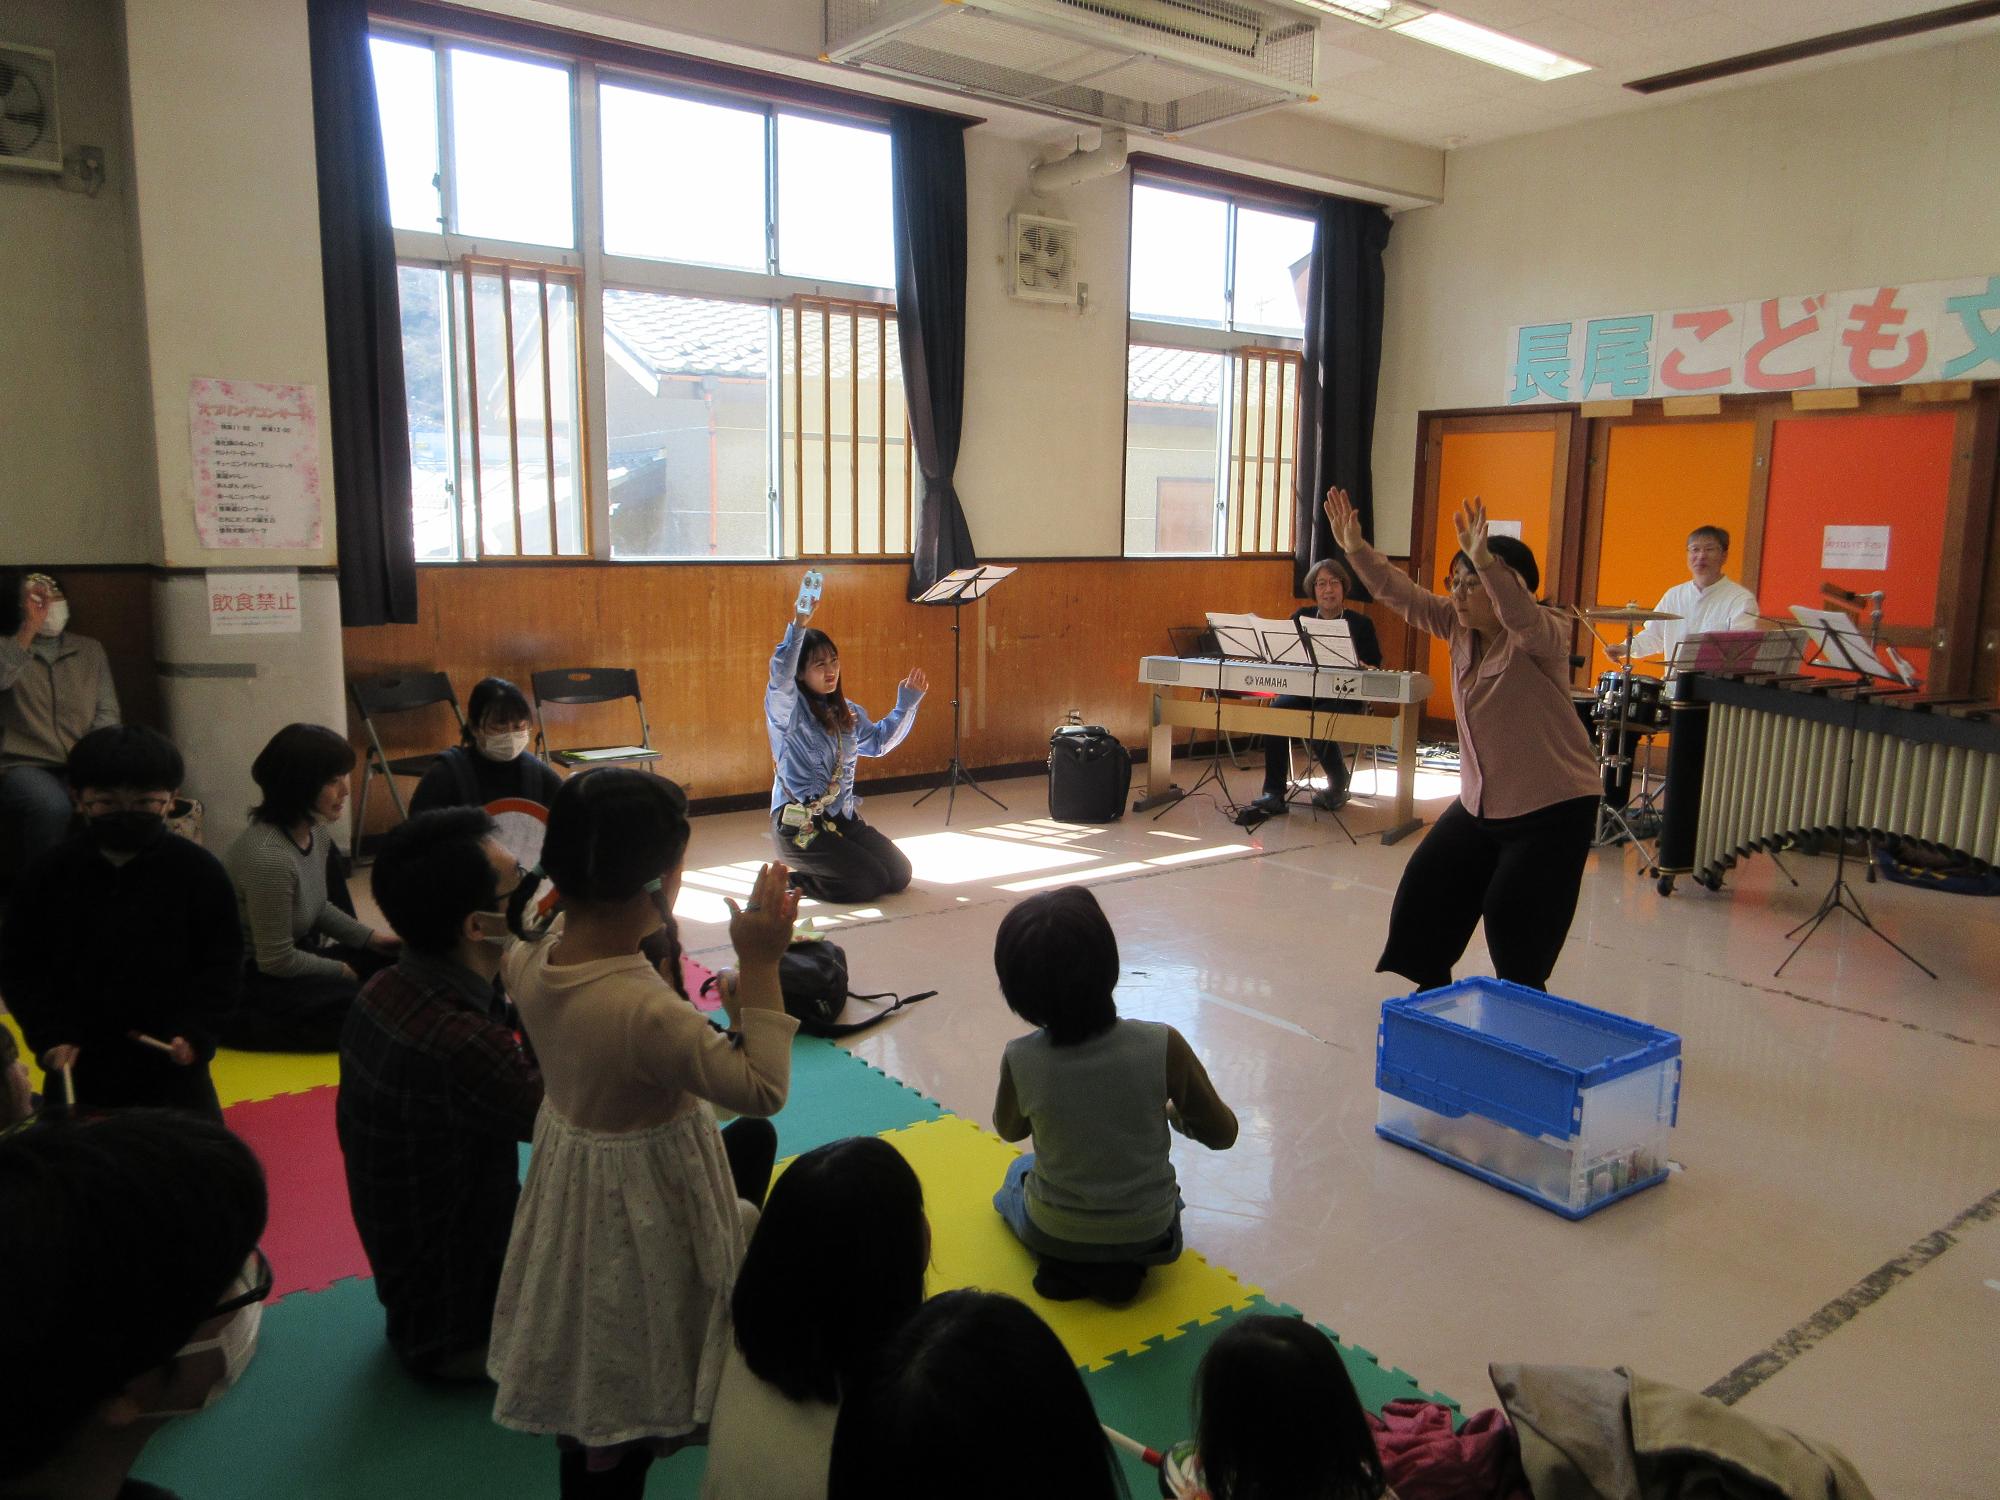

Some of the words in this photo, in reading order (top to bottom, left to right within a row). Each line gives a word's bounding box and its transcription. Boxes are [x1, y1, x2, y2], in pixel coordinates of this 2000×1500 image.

[211, 592, 297, 612] 飲食禁止
[1255, 676, 1288, 688] YAMAHA
